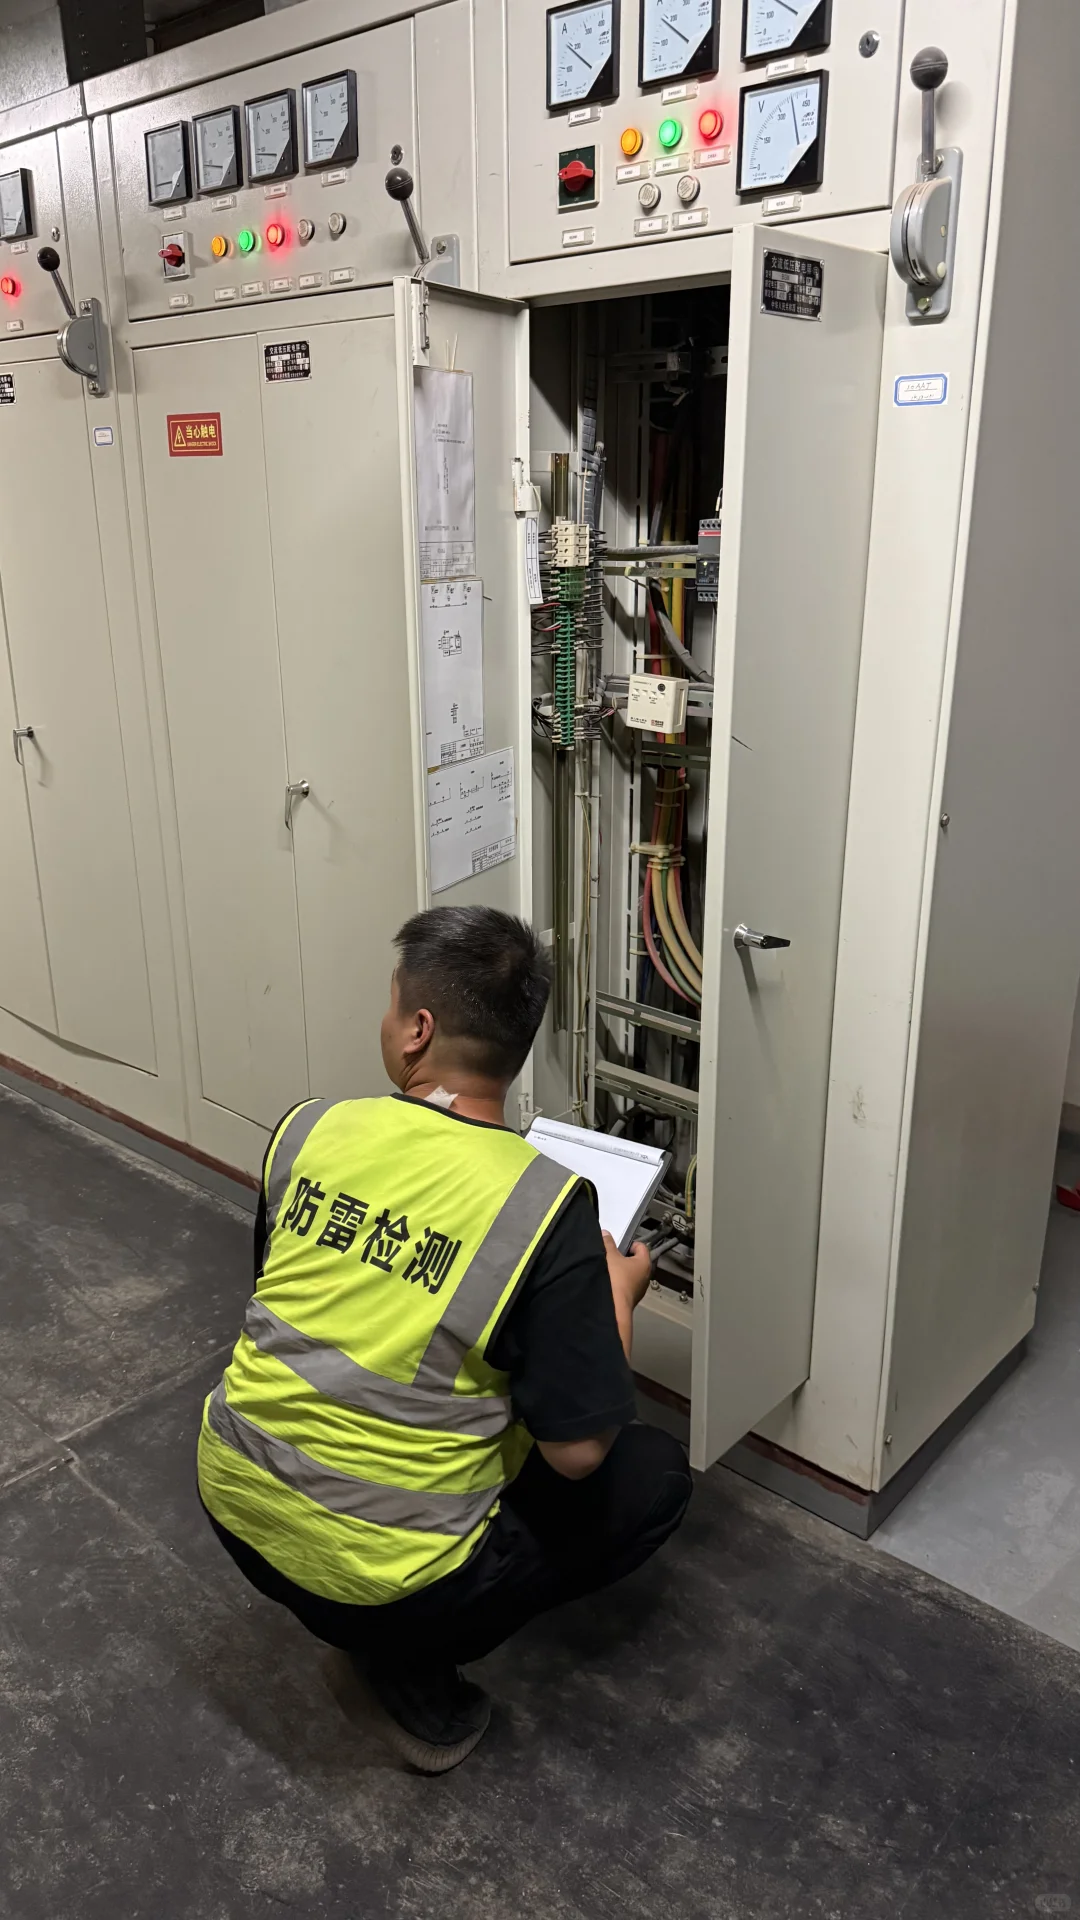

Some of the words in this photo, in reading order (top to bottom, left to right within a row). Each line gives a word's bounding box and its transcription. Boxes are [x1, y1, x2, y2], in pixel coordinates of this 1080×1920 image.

[766, 11, 774, 19] 100
[561, 22, 568, 35] A
[314, 93, 319, 104] A
[758, 100, 765, 114] V
[185, 424, 217, 439] 当心触电
[281, 1176, 463, 1295] 防雷检测
